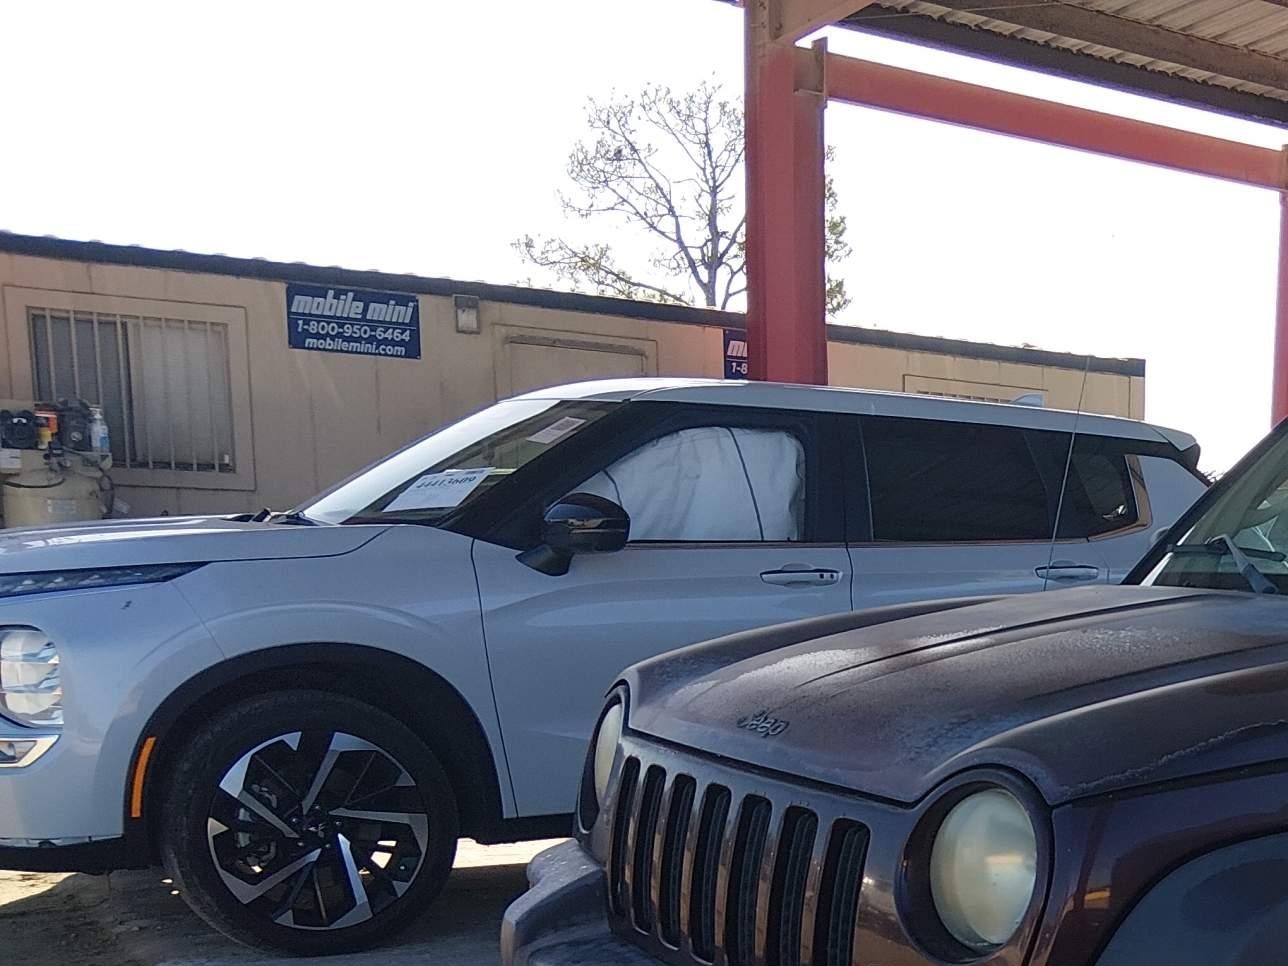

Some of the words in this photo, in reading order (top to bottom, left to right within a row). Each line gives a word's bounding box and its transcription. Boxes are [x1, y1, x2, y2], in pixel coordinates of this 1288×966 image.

[291, 290, 364, 319] mobile
[366, 301, 416, 323] mini
[297, 320, 411, 342] 1-800-950-6464
[304, 338, 406, 356] mobilemini.com
[736, 708, 790, 738] Jeep
